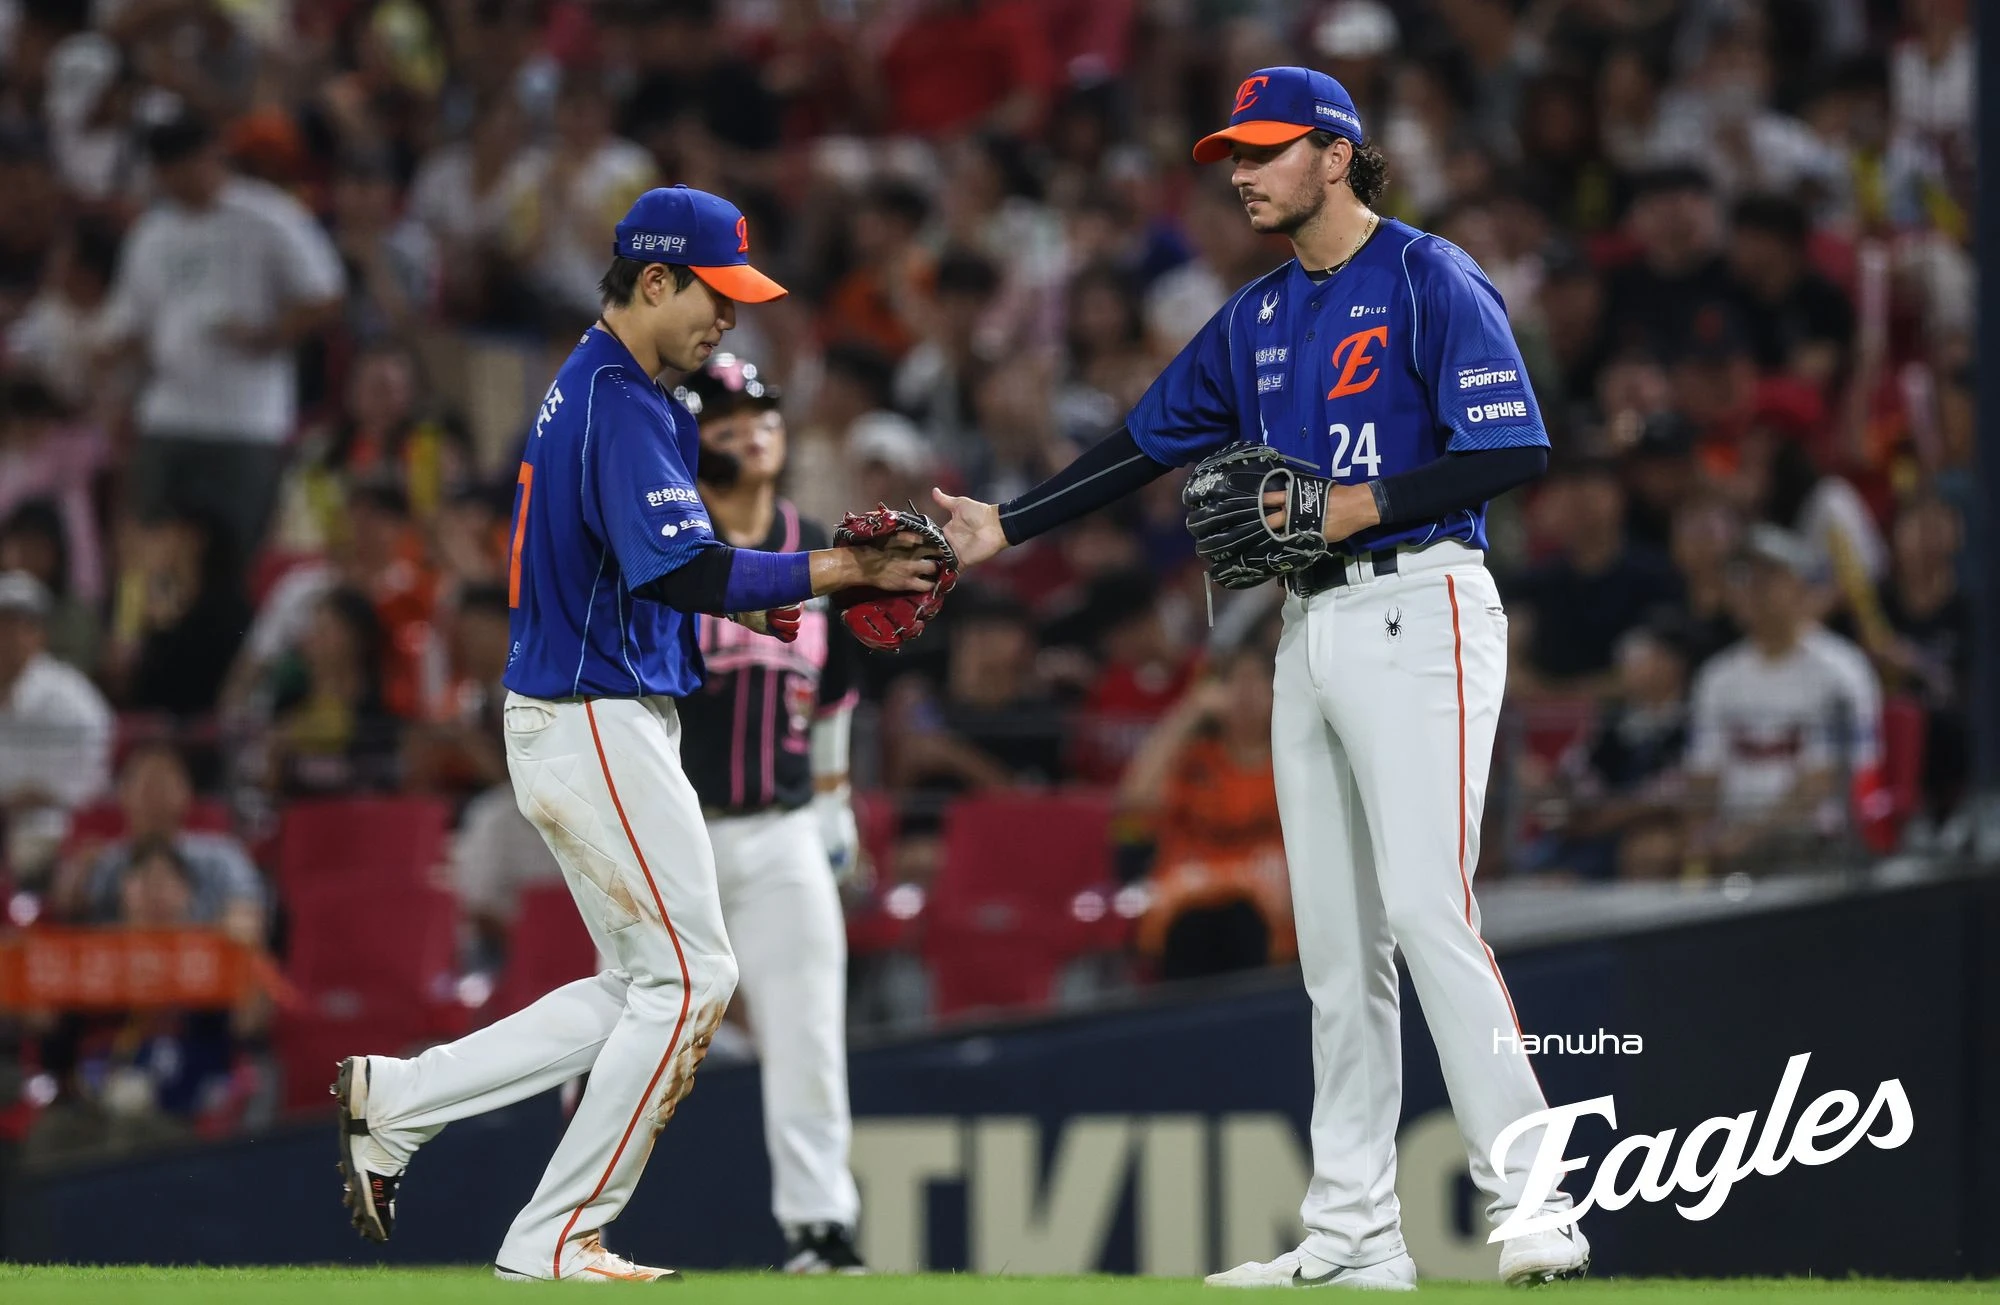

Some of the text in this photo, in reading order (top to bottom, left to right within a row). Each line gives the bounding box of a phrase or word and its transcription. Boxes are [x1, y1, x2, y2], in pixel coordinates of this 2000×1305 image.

[631, 232, 687, 253] 삼일제약
[1365, 305, 1387, 315] PLUS
[1460, 370, 1518, 389] SPORTSIX
[1483, 401, 1527, 419] 알바몬
[1329, 422, 1382, 478] 24
[646, 487, 700, 507] 한화오션
